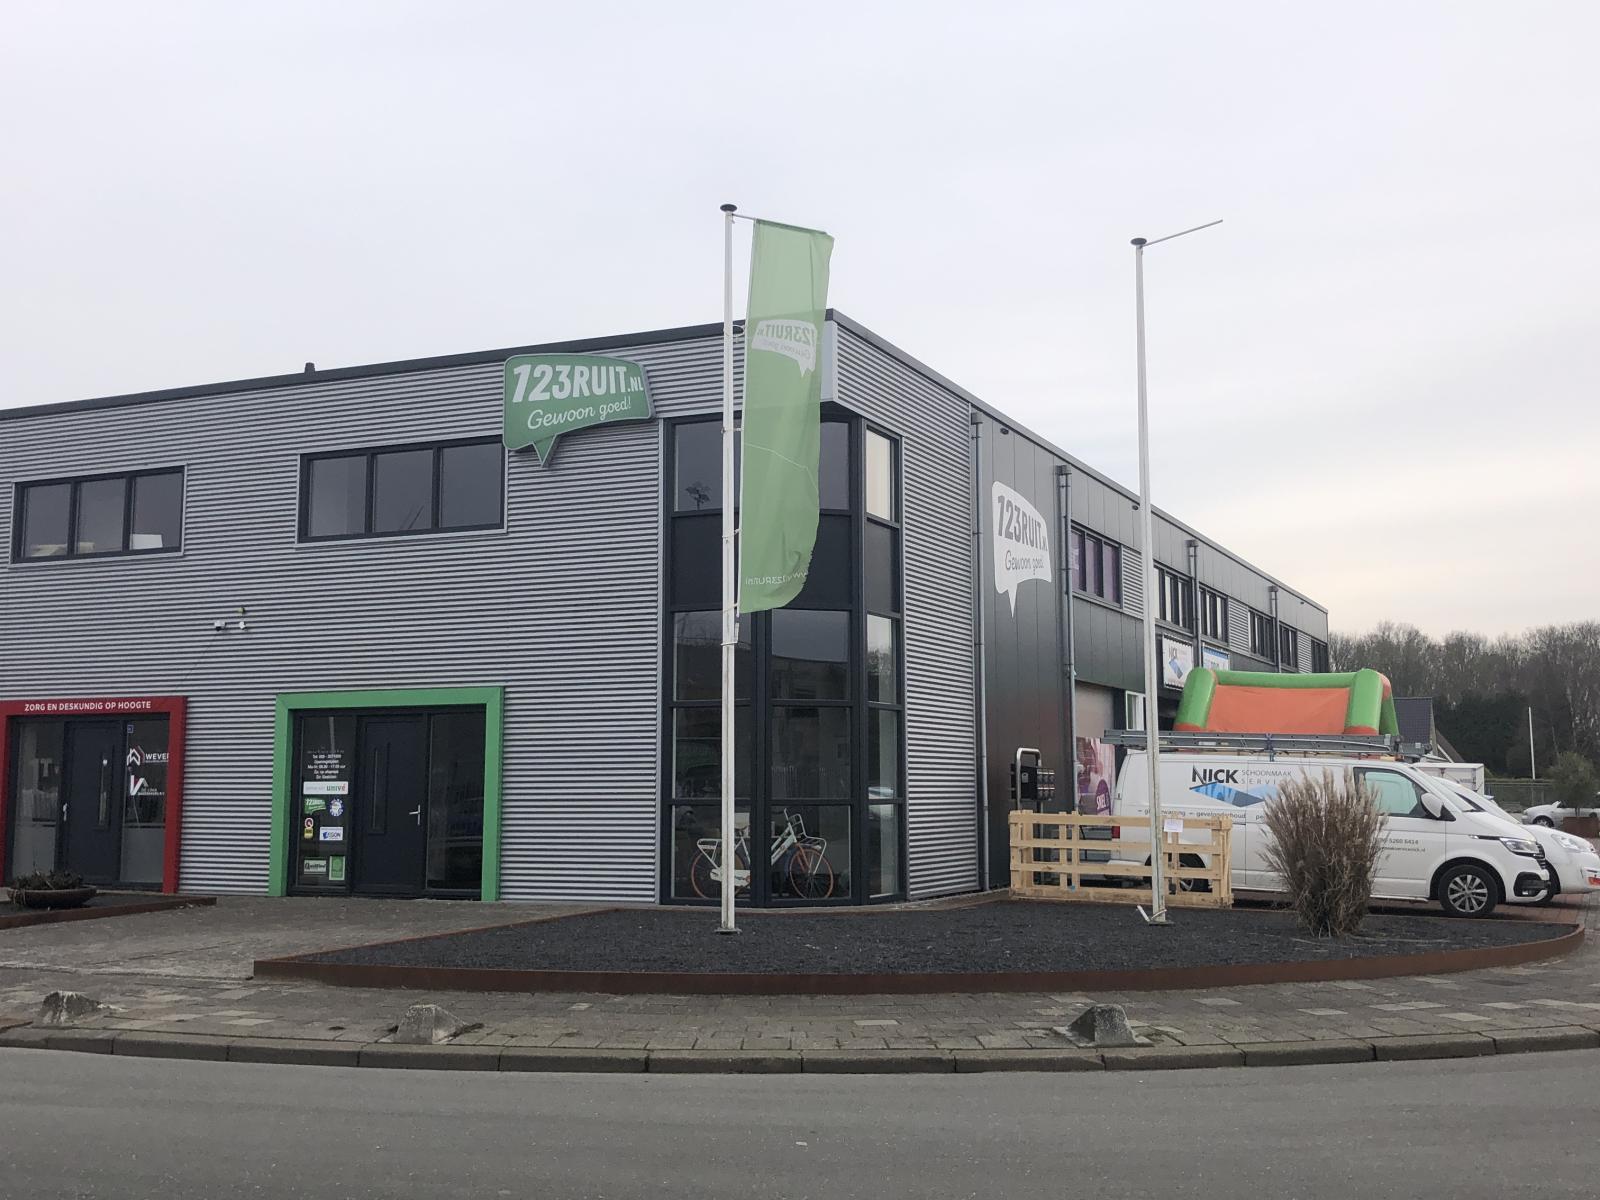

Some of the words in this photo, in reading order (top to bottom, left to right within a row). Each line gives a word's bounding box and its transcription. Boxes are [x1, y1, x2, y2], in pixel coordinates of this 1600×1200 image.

[512, 364, 644, 403] 123RUIT.NL
[527, 408, 595, 430] Gewoon
[599, 396, 632, 421] goed!
[24, 703, 46, 712] ZORG
[47, 703, 57, 711] EN
[59, 702, 103, 711] DESKUNDIG
[105, 702, 117, 710] OP
[118, 701, 151, 709] HOOGTE
[1192, 765, 1239, 784] NICK
[1241, 769, 1292, 777] SCHOONMAAK
